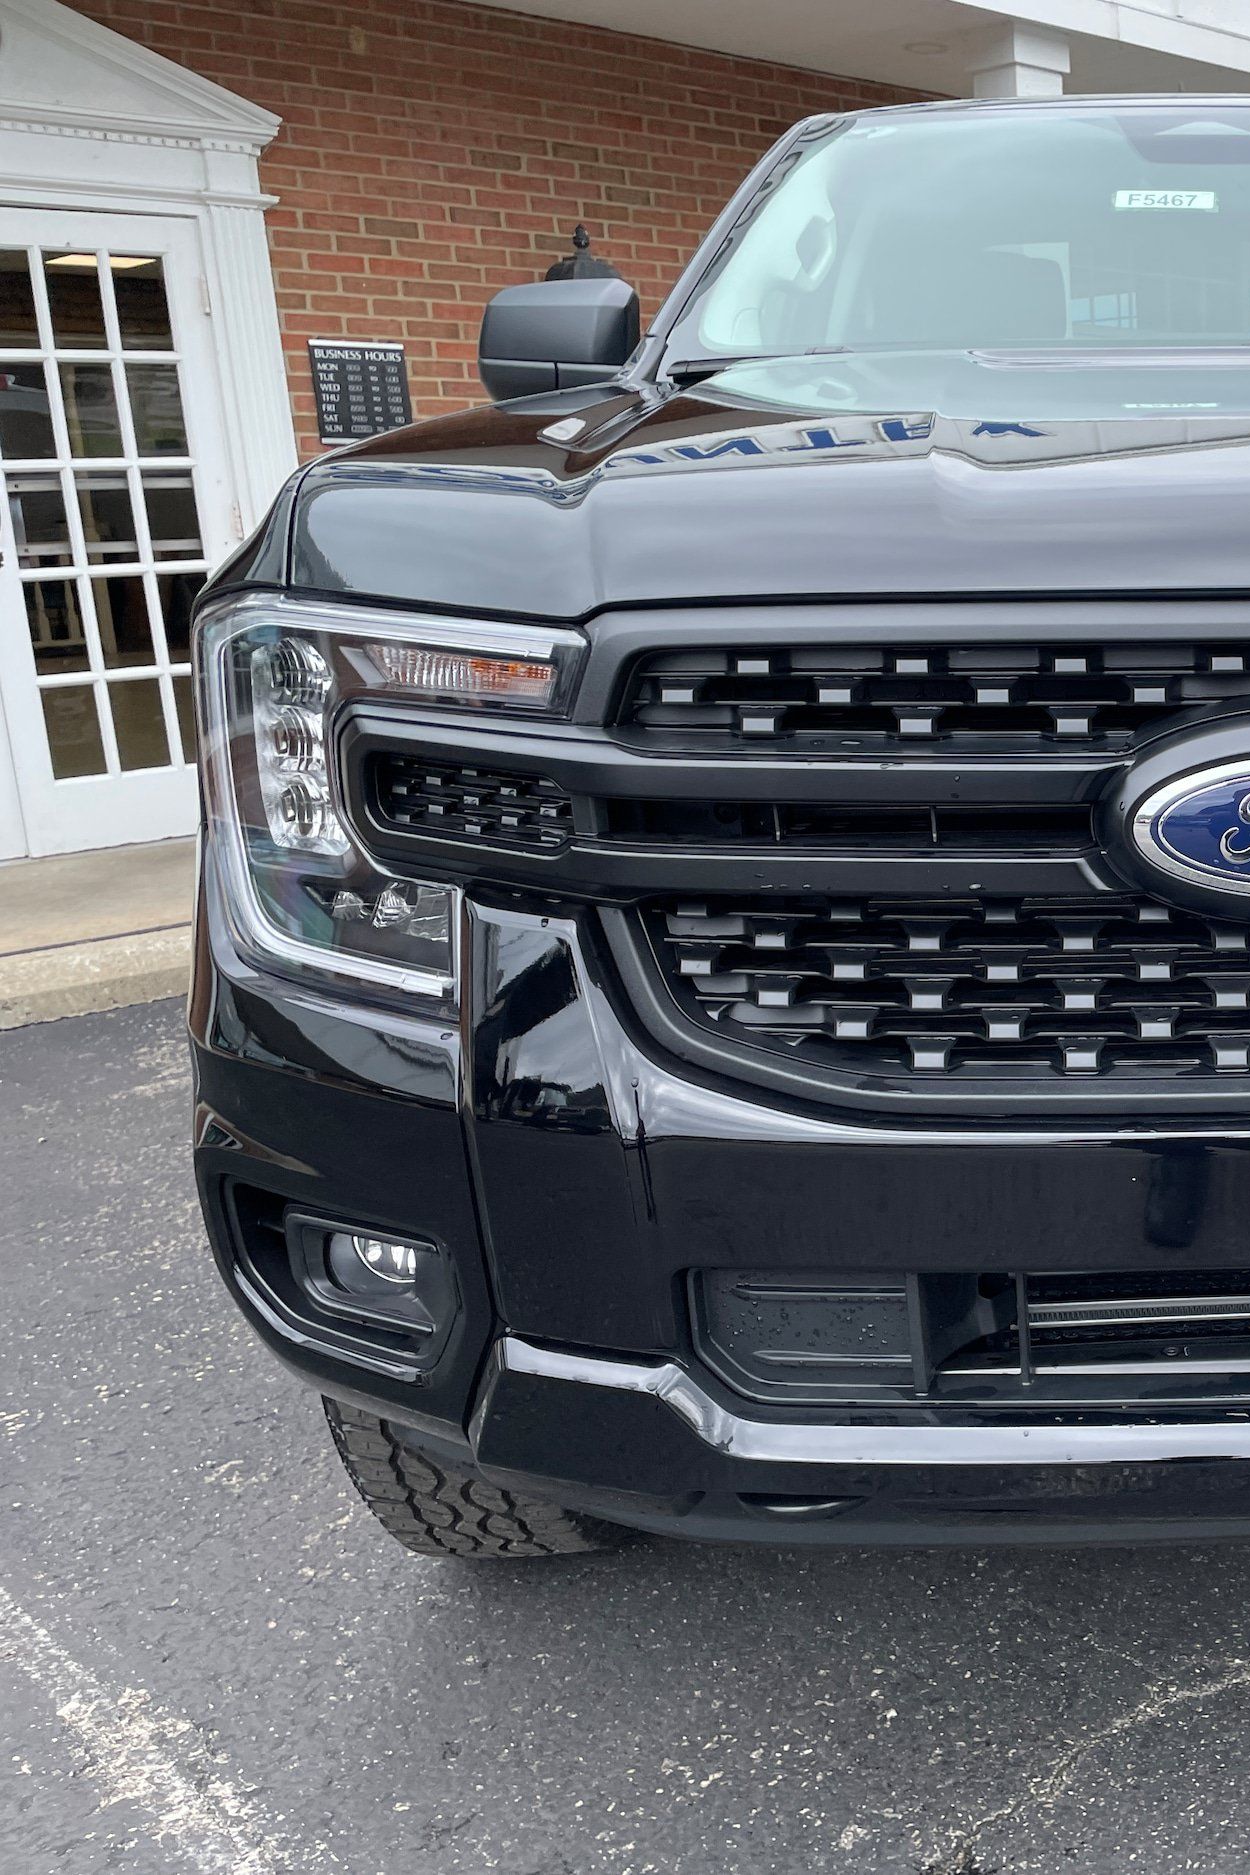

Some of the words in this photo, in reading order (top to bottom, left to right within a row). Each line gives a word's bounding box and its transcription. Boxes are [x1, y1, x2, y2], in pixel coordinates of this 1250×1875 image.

[1128, 194, 1198, 206] F5467
[314, 349, 361, 361] BUSINESS
[365, 351, 401, 362] HOURS
[317, 363, 339, 371] MON
[318, 373, 334, 381] TUE
[320, 383, 340, 392] WED
[321, 394, 340, 402] THU
[322, 404, 336, 412] FRI
[323, 414, 339, 422] SAT
[325, 425, 343, 433] SUN
